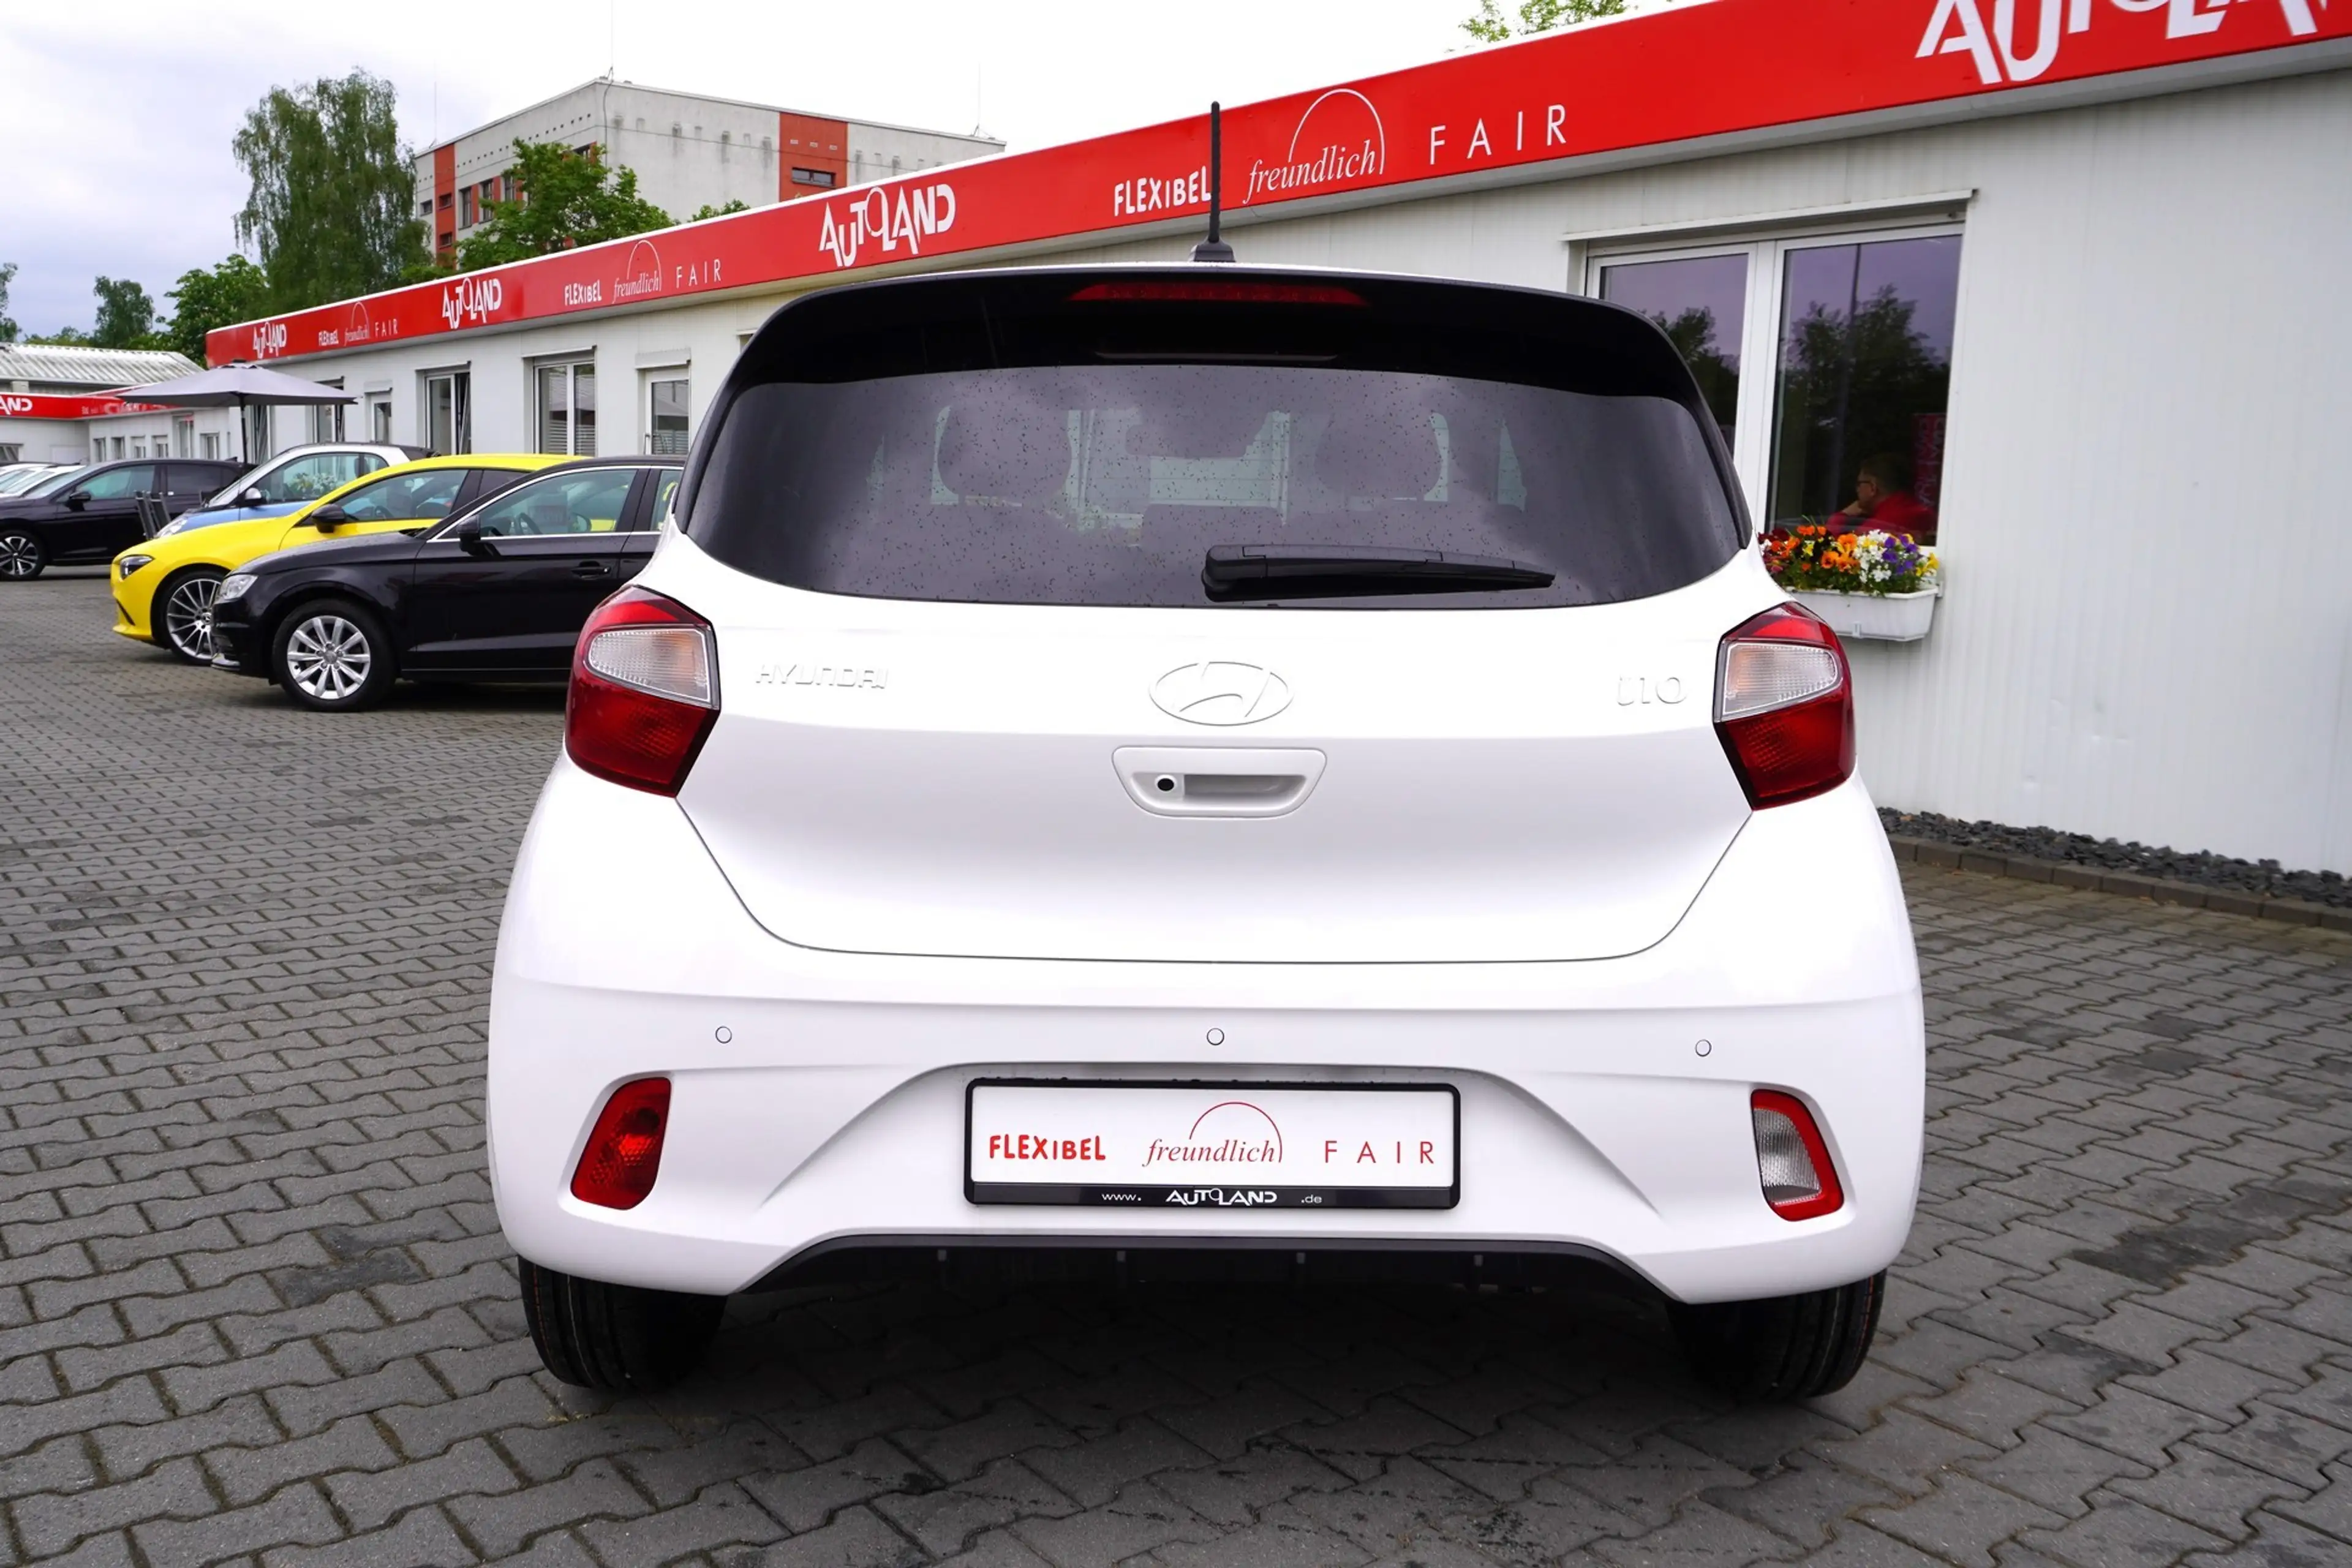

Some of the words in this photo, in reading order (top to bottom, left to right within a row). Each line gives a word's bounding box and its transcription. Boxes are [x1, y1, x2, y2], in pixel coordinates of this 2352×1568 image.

[1114, 165, 1212, 216] FLEXIBEL
[1243, 141, 1376, 205] freundlich
[1430, 104, 1567, 165] FAIR
[819, 184, 956, 267] AUTOLAND
[565, 279, 602, 306] FLEXIBEL
[612, 271, 660, 304] freundlich
[676, 258, 722, 288] FAIR
[442, 277, 502, 329] AUTOLAND
[375, 318, 398, 338] FAIR
[755, 663, 888, 690] HYUNDAI
[989, 1134, 1107, 1161] FLEXIBEL
[1142, 1139, 1276, 1168] freundlich
[1324, 1140, 1434, 1164] FAIR
[1101, 1193, 1142, 1202] www.
[1165, 1188, 1278, 1207] AUTOLAND
[1300, 1194, 1323, 1204] .de
